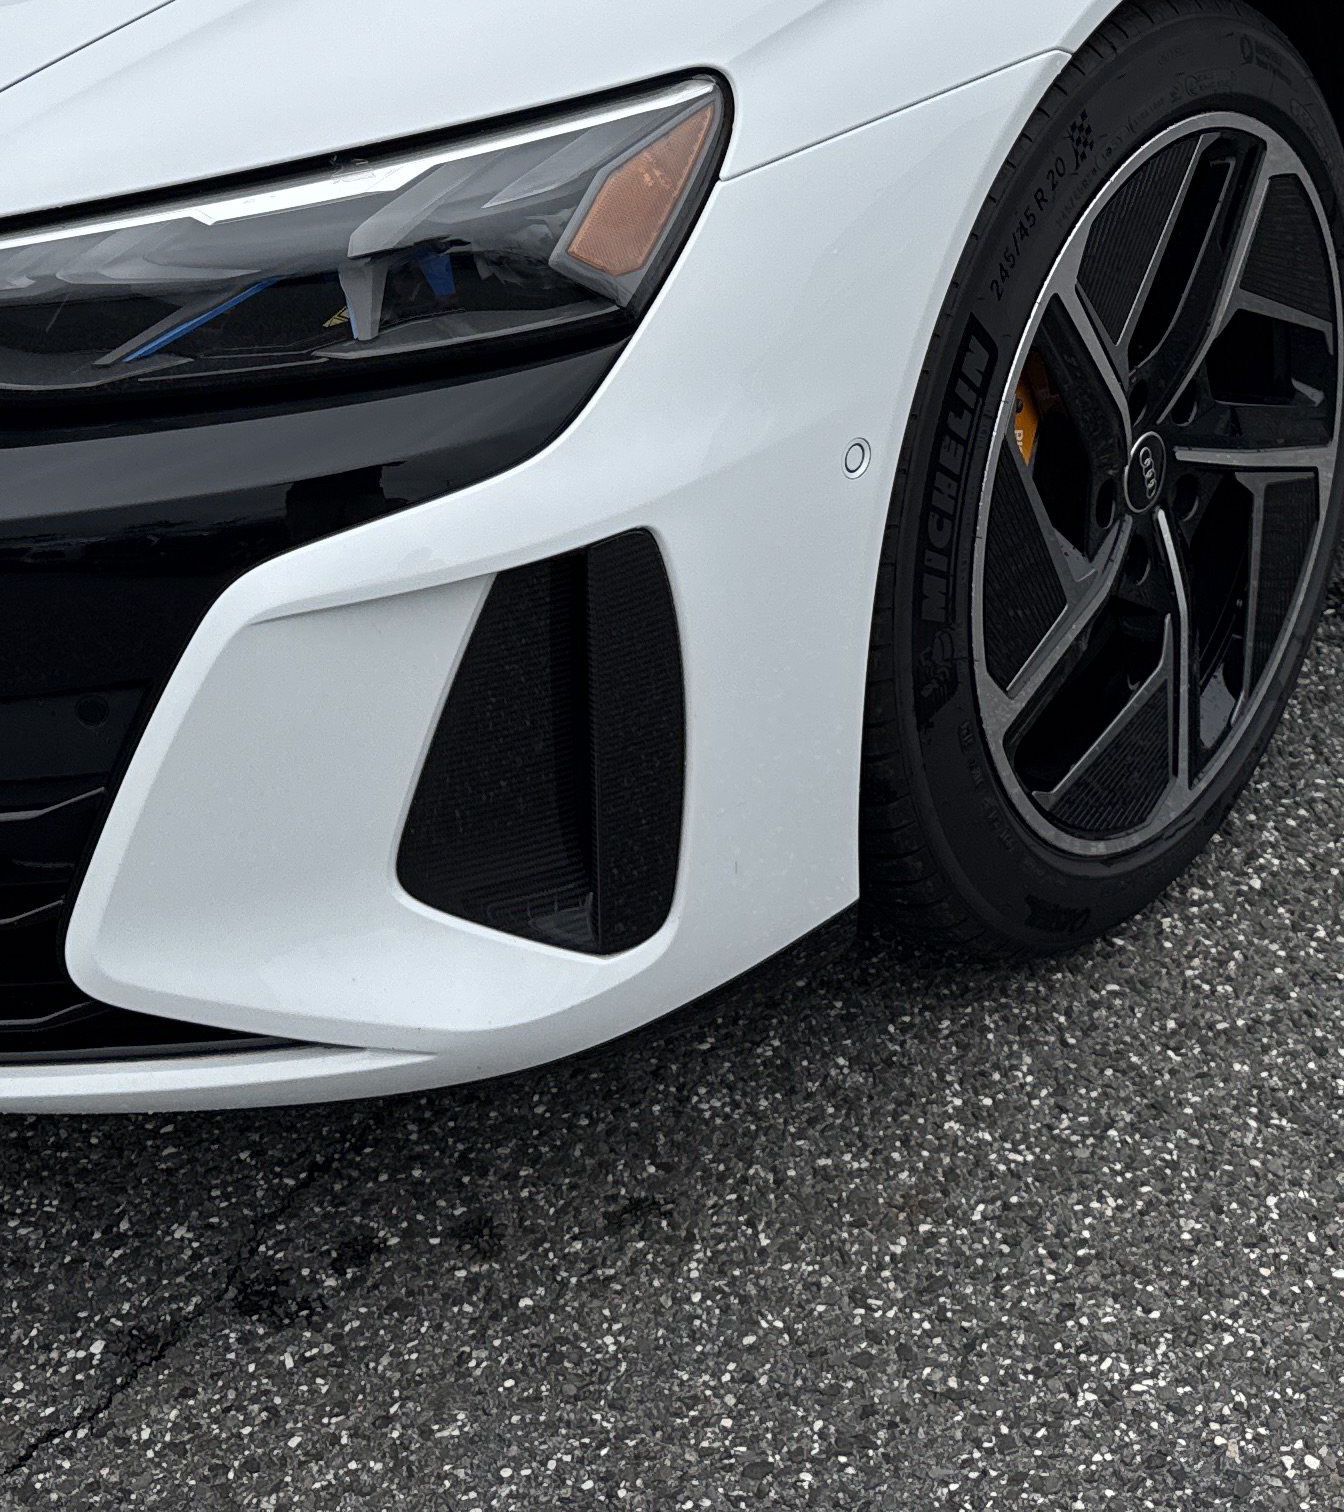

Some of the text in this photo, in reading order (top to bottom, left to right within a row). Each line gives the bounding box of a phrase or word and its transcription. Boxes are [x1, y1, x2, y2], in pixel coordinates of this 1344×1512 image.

[990, 208, 1038, 301] 245/45
[1050, 158, 1067, 191] 20
[921, 334, 991, 623] MICHELIN
